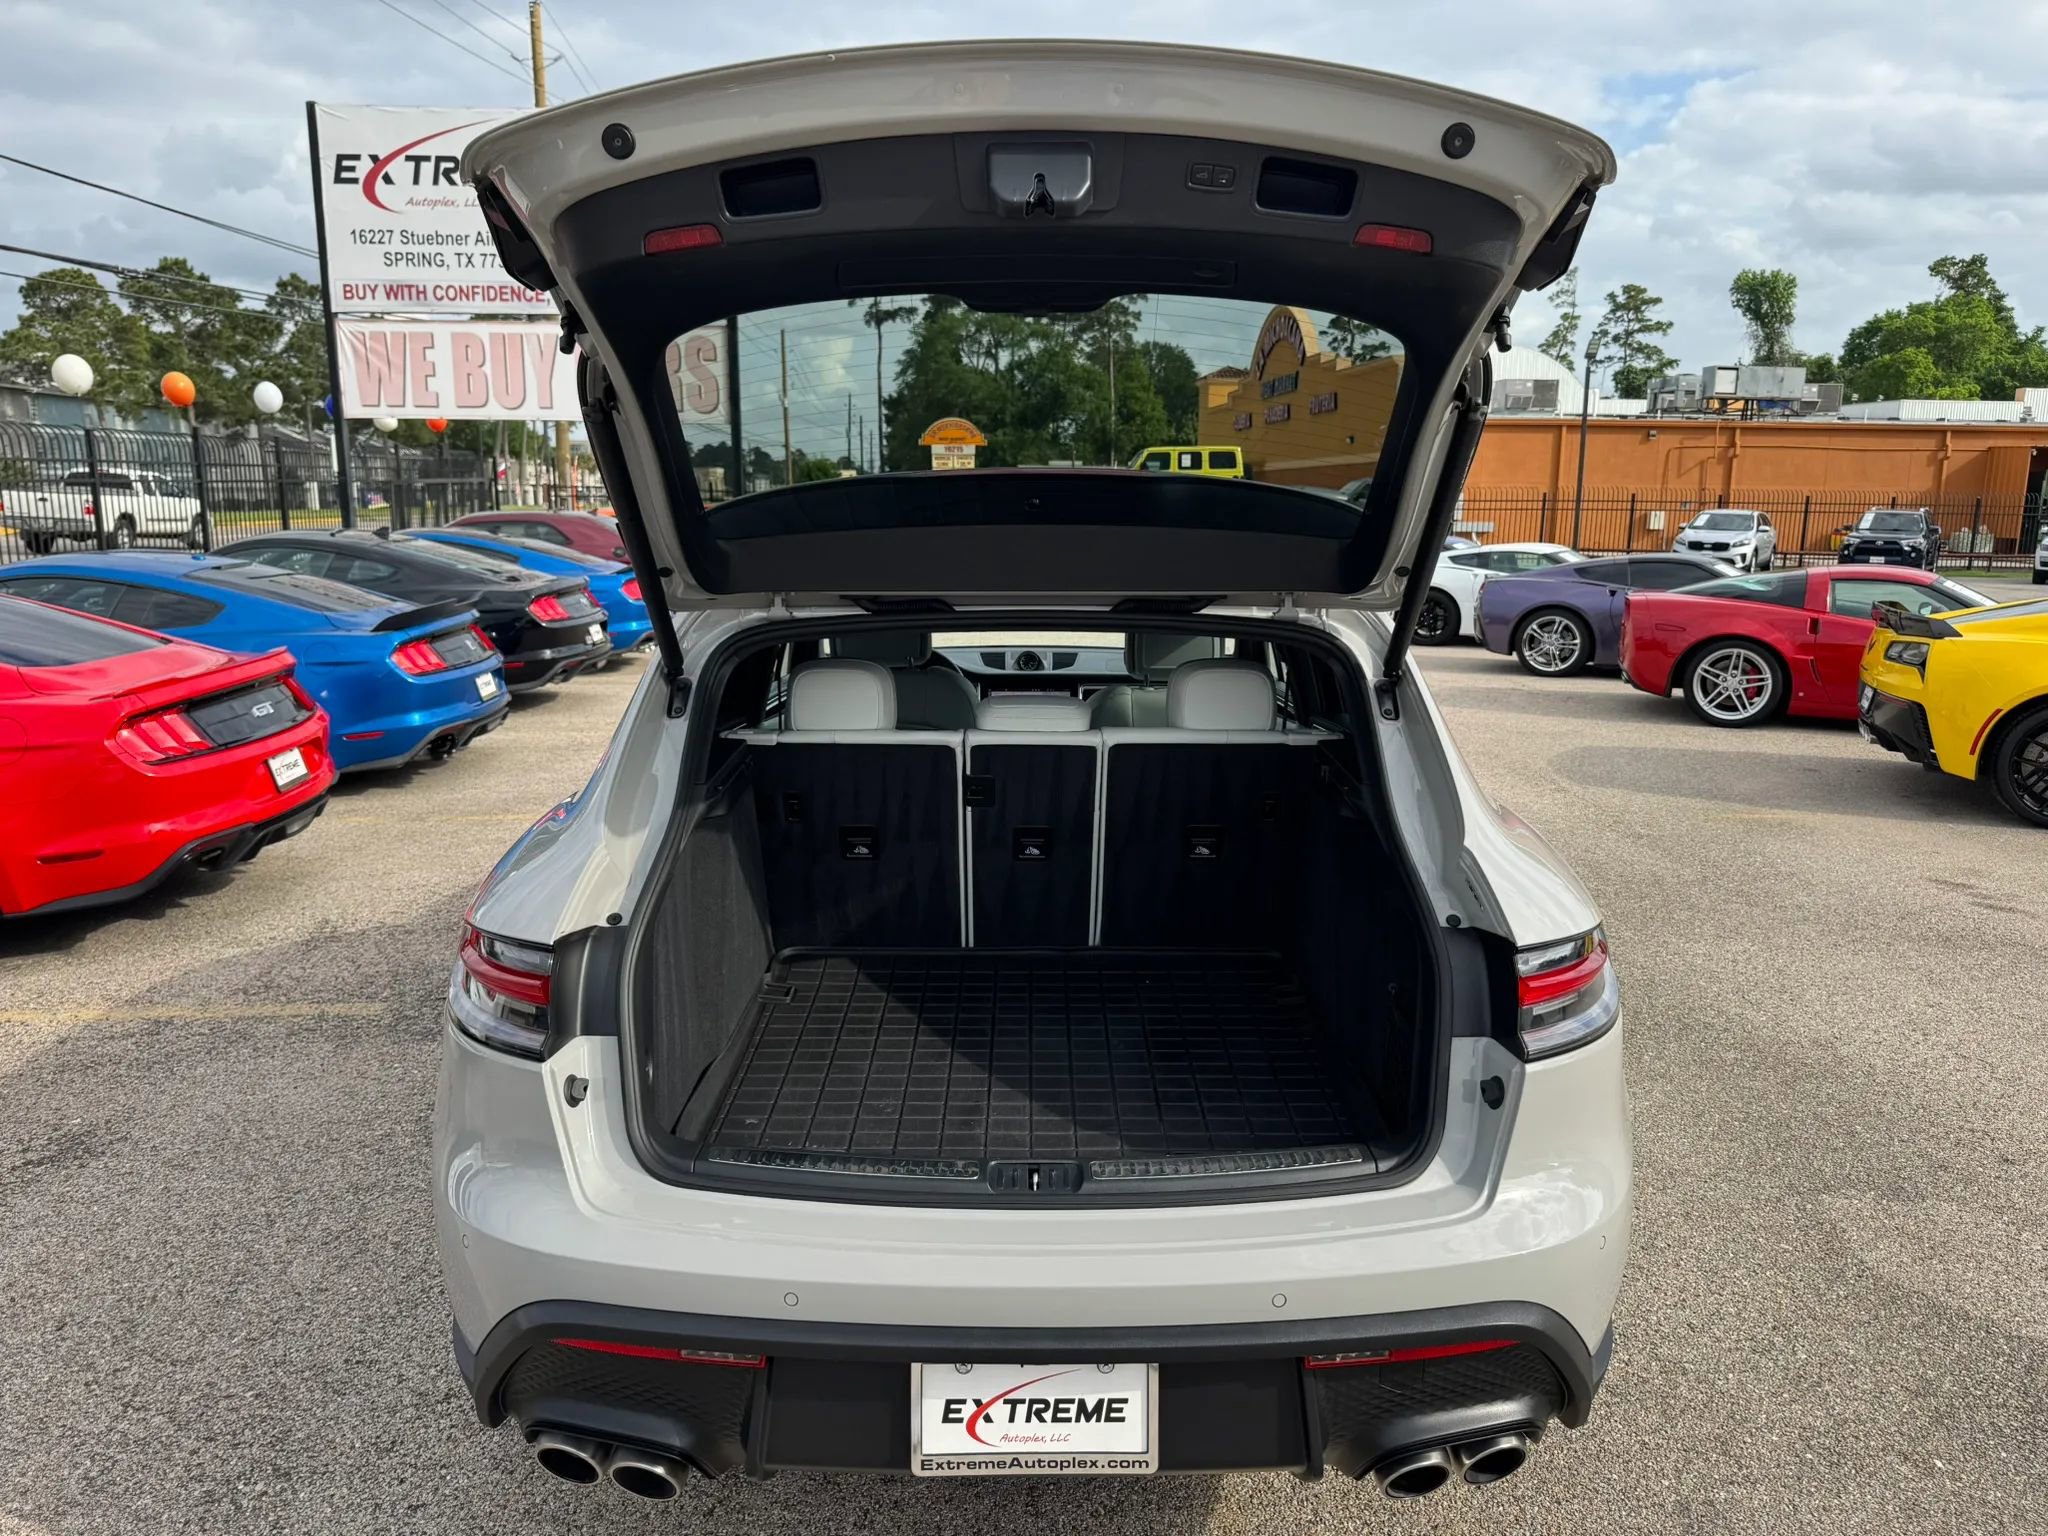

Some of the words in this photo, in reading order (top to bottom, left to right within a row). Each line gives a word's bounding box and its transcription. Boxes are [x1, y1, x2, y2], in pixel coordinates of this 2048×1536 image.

[333, 153, 460, 187] EXTR
[405, 196, 460, 211] Autoplex,
[464, 197, 481, 208] LL
[350, 229, 394, 246] 16227
[399, 229, 471, 247] Stuebner
[383, 251, 451, 272] SPRING,
[454, 252, 476, 269] TX
[342, 283, 379, 301] BUY
[383, 284, 428, 302] WITH
[432, 284, 551, 306] CONFIDENCE,
[352, 330, 440, 409] WE
[451, 331, 559, 411] BUY
[941, 1397, 1129, 1424] EXTREME
[999, 1432, 1048, 1445] Autoplex,
[1050, 1432, 1072, 1442] LLC
[920, 1456, 1150, 1472] ExtremeAutoplex.com
